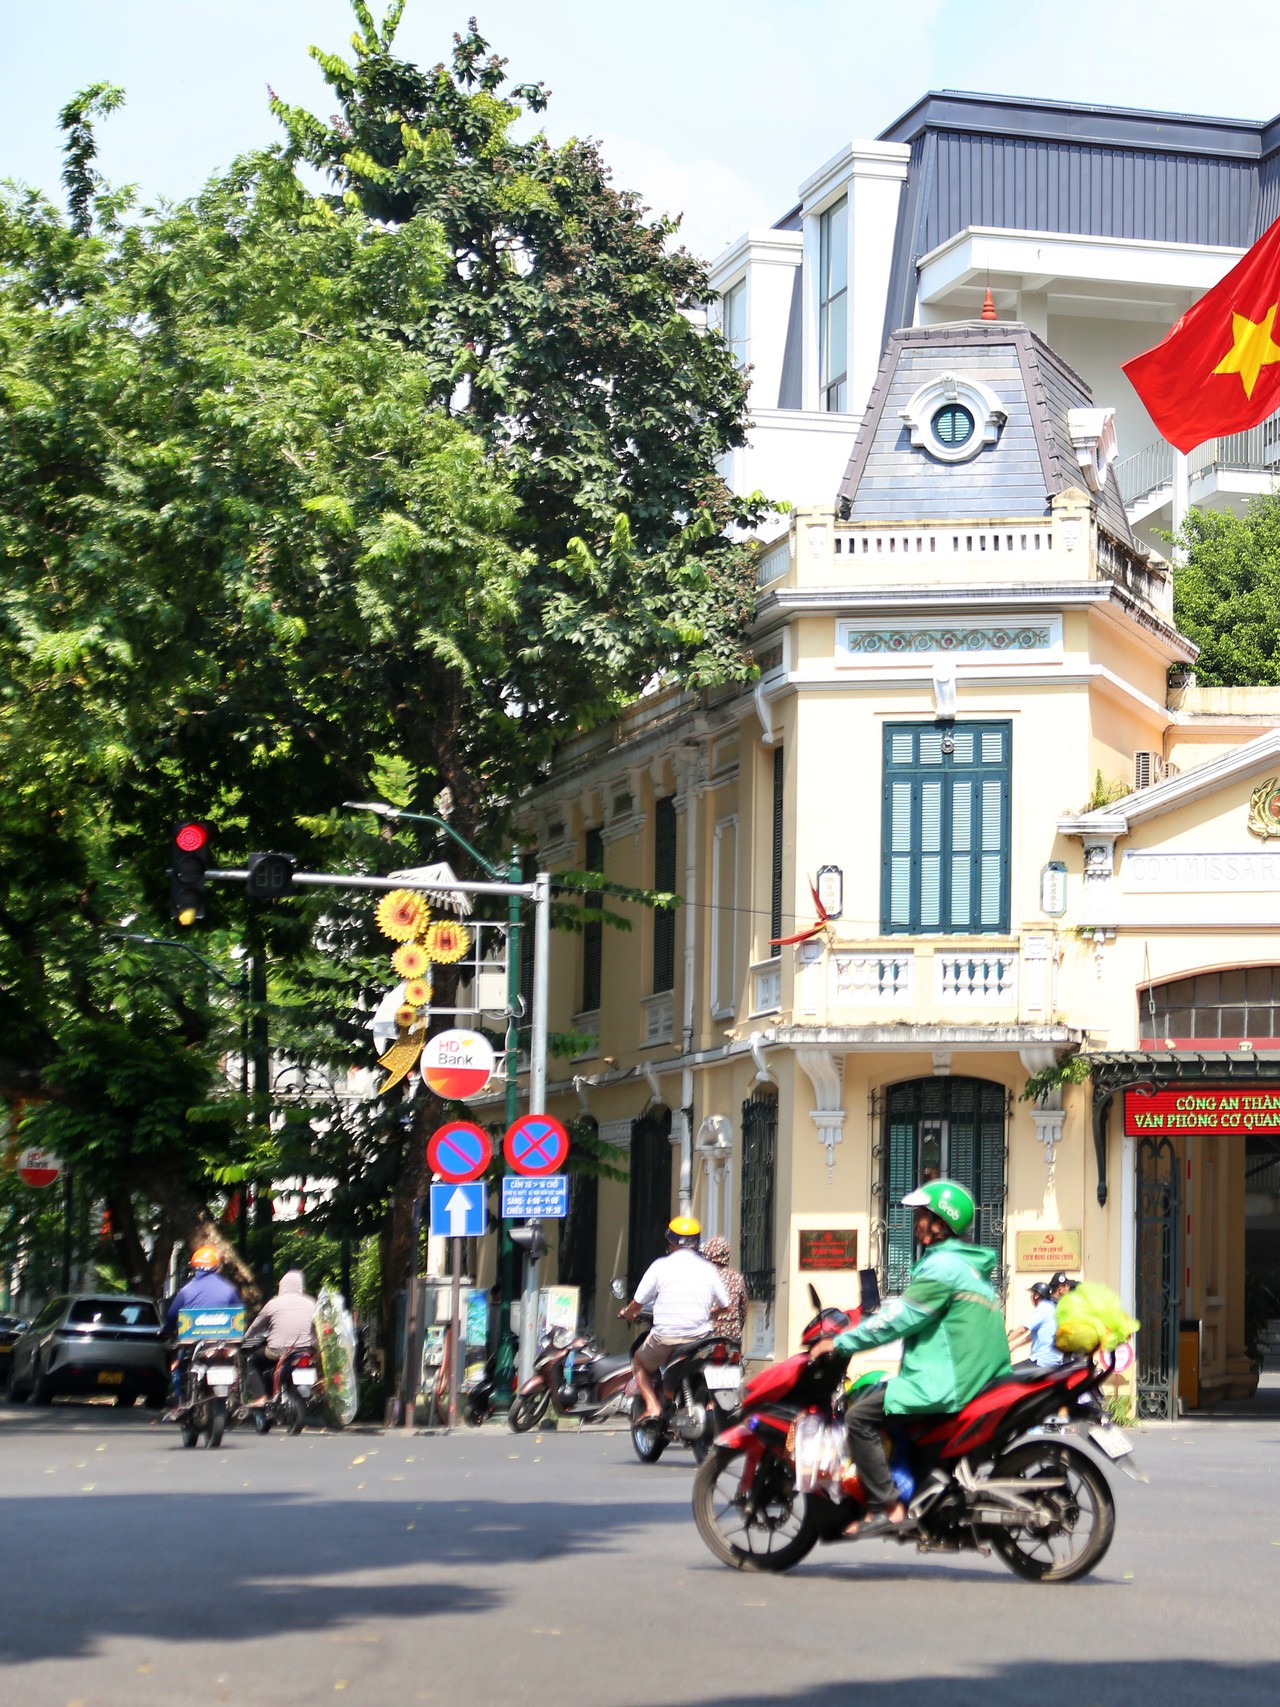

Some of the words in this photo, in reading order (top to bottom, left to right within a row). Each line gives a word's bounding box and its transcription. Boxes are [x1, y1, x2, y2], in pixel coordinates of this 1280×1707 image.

[438, 1040, 460, 1053] HD
[438, 1053, 473, 1066] Bank
[1176, 1095, 1216, 1110] CÔNG
[1219, 1097, 1239, 1110] AN
[1134, 1112, 1164, 1128] VĂN
[1167, 1112, 1218, 1128] PHÒNG
[1220, 1113, 1241, 1127] CƠ
[27, 1160, 48, 1168] Bank
[510, 1179, 523, 1188] CẤM
[938, 1200, 960, 1221] Grab
